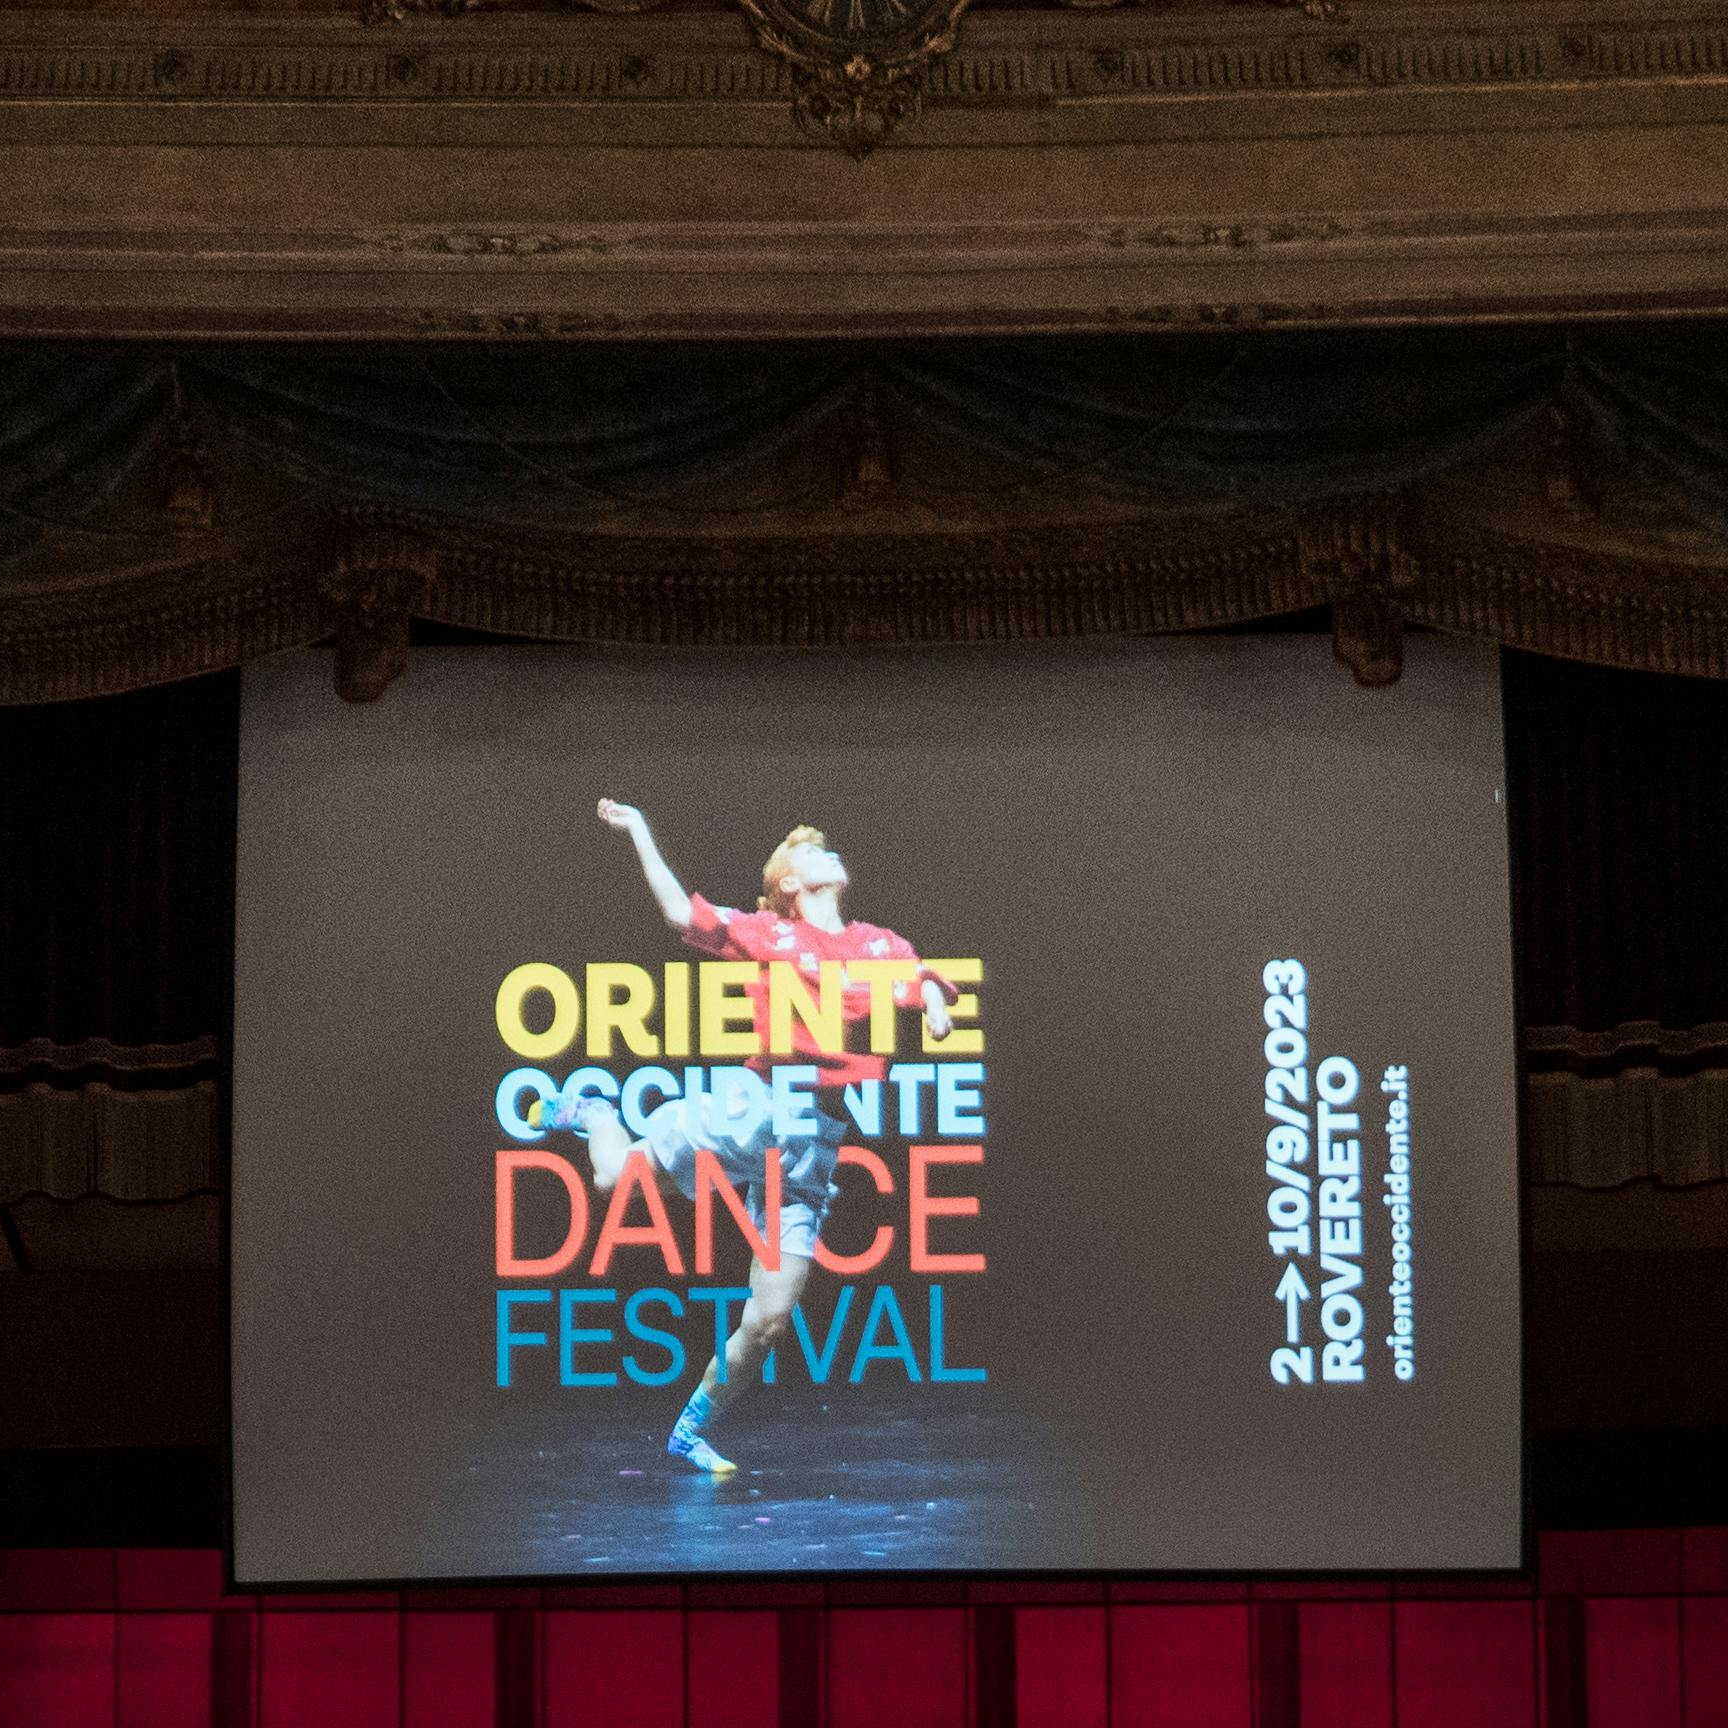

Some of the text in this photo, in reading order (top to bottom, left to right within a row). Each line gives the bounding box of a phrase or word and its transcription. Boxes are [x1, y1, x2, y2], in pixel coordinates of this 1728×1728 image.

[495, 958, 985, 1058] ORIENTE
[495, 1145, 986, 1276] DANCE
[1262, 957, 1314, 1385] 2 10/9/2023
[1316, 1055, 1366, 1384] ROVERETO
[1381, 1064, 1415, 1382] orienteoccidente.it
